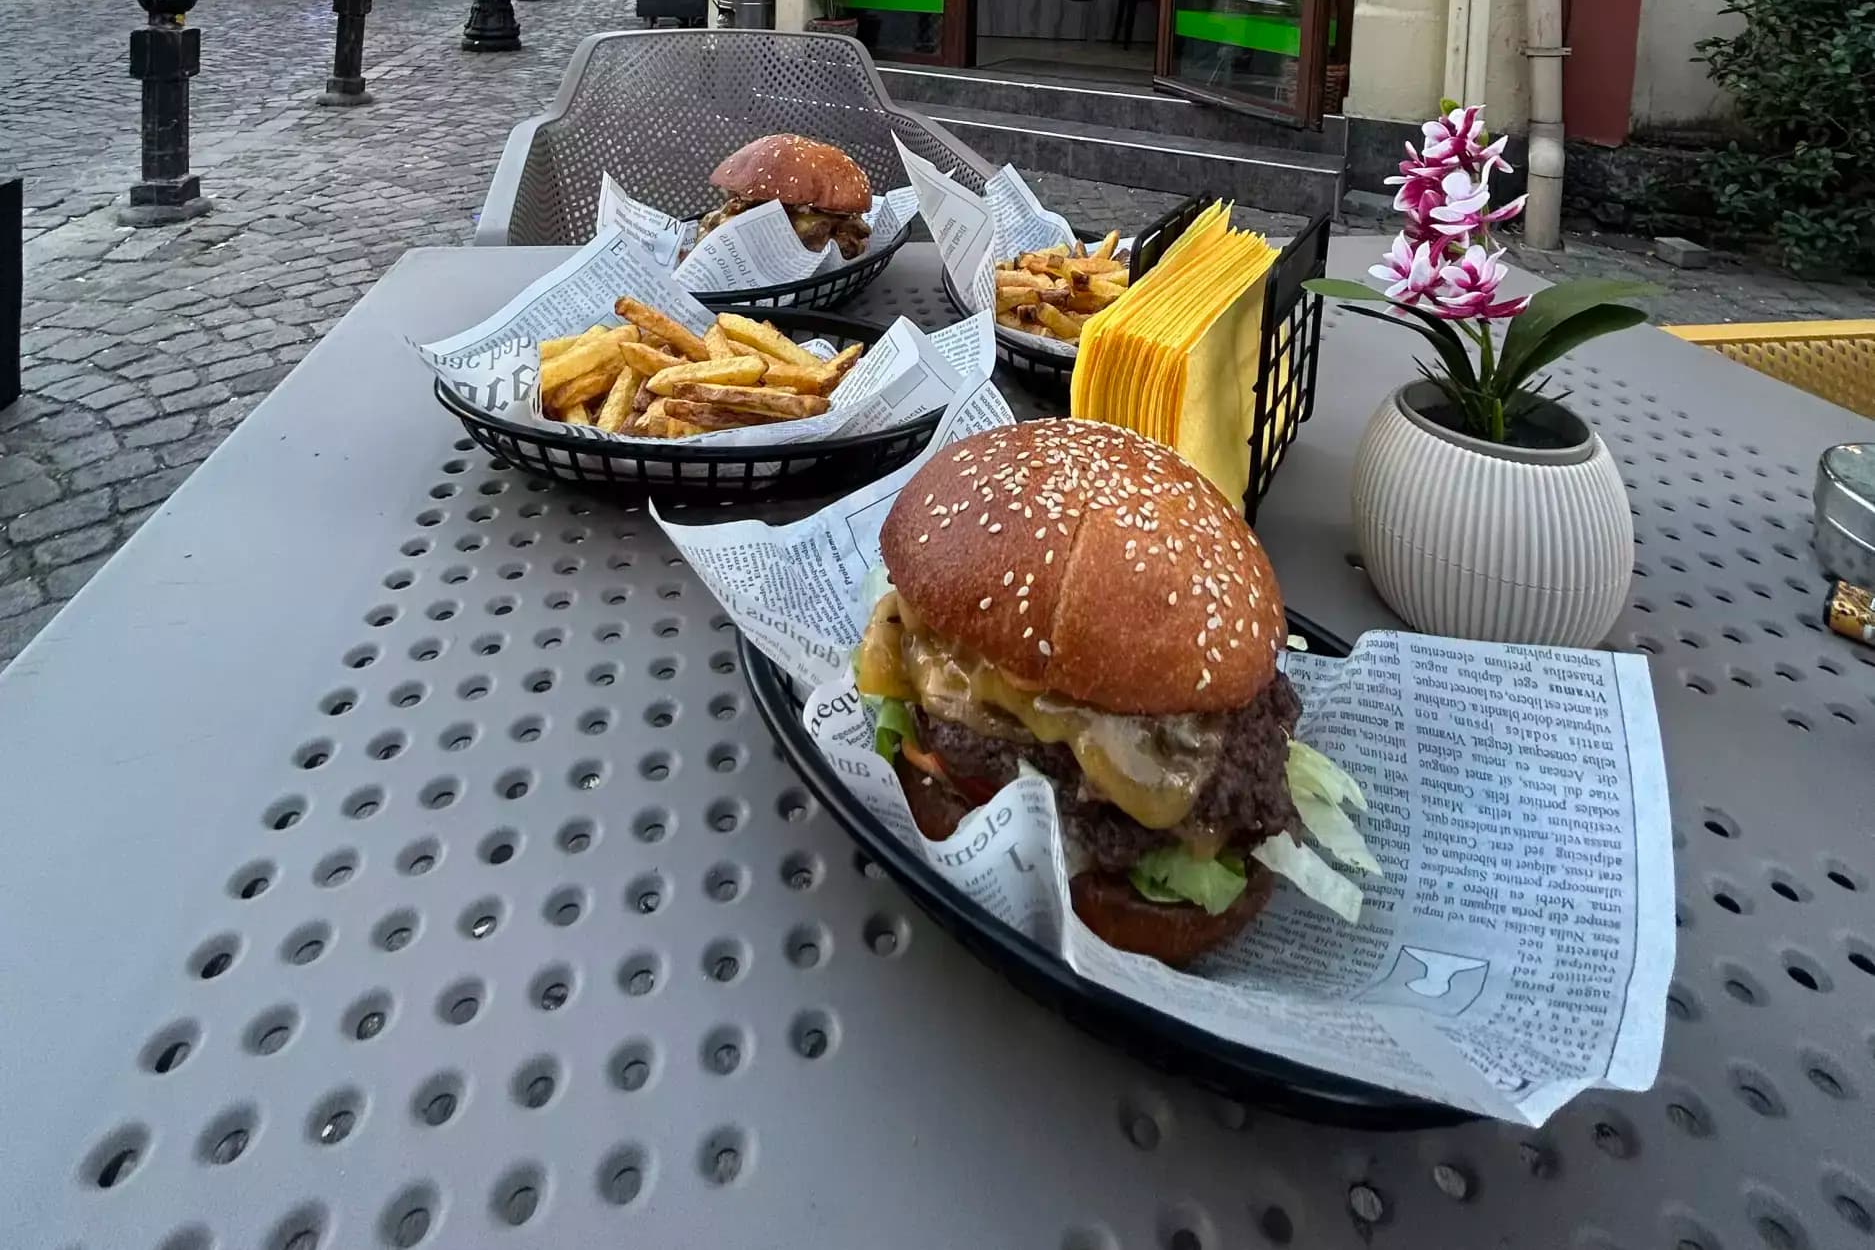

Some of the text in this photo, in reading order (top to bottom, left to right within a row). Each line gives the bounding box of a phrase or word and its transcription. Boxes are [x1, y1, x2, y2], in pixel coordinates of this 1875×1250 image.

[1366, 639, 1399, 653] laoreet
[1379, 654, 1400, 666] quis
[1554, 653, 1560, 661] a
[1562, 654, 1601, 667] sapien
[1410, 645, 1604, 686] Phasellus pretium elementum
[1368, 668, 1401, 684] lacinia
[1458, 668, 1503, 686] dapibus
[1513, 676, 1538, 689] eget
[1366, 684, 1402, 700] feugiat
[1413, 675, 1608, 718] sit amet est libero, eu laoreet neque,
[1549, 684, 1606, 704] Vivamus
[1358, 698, 1404, 717] Vivamus
[1414, 693, 1466, 712] Curabitur
[1340, 711, 1404, 731] at accumsan
[1480, 704, 1520, 723] blandit
[1522, 712, 1553, 728] dolor
[1415, 708, 1614, 751] mattis sodales ipsum, non
[1555, 718, 1611, 735] vulputate
[1360, 728, 1406, 749] ultricies,
[1416, 726, 1466, 747] Vivamus
[1356, 744, 1407, 764] pretium,
[1518, 744, 1577, 763] consequat
[1418, 742, 1584, 782] Aenean eu metus eleifend
[1582, 755, 1616, 770] tellus
[1342, 760, 1408, 782] velit iaculis
[1419, 759, 1619, 801] vitae dui lectus, sit amet congue
[1420, 777, 1474, 798] Curabitur
[1373, 783, 1409, 803] lacinia
[1575, 804, 1620, 818] sodales
[1368, 817, 1410, 838] fringilla
[1450, 817, 1498, 833] molestie
[1500, 826, 1510, 834] ut
[1548, 816, 1621, 834] vestibulum
[1422, 830, 1477, 849] Curabitur
[1513, 828, 1548, 840] mattis
[1524, 846, 1544, 857] sed
[1583, 837, 1622, 850] massa
[1376, 854, 1409, 870] Donec
[1442, 849, 1497, 868] bibendum
[1501, 858, 1512, 868] in
[1556, 847, 1622, 868] adipiscing
[1420, 862, 1488, 882] Suspendisse
[1516, 859, 1556, 875] aliquet
[1562, 865, 1594, 878] risus,
[1419, 877, 1437, 889] dui
[1447, 881, 1454, 889] a
[1547, 879, 1622, 899] ullamcorper
[1416, 891, 1439, 902] quis
[1463, 884, 1498, 899] libero
[1444, 896, 1454, 904] ut
[1536, 894, 1574, 910] Morbi
[1447, 912, 1464, 922] vel
[1468, 915, 1496, 929] Nam
[1550, 928, 1584, 943] Nulla
[1512, 966, 1536, 976] sed
